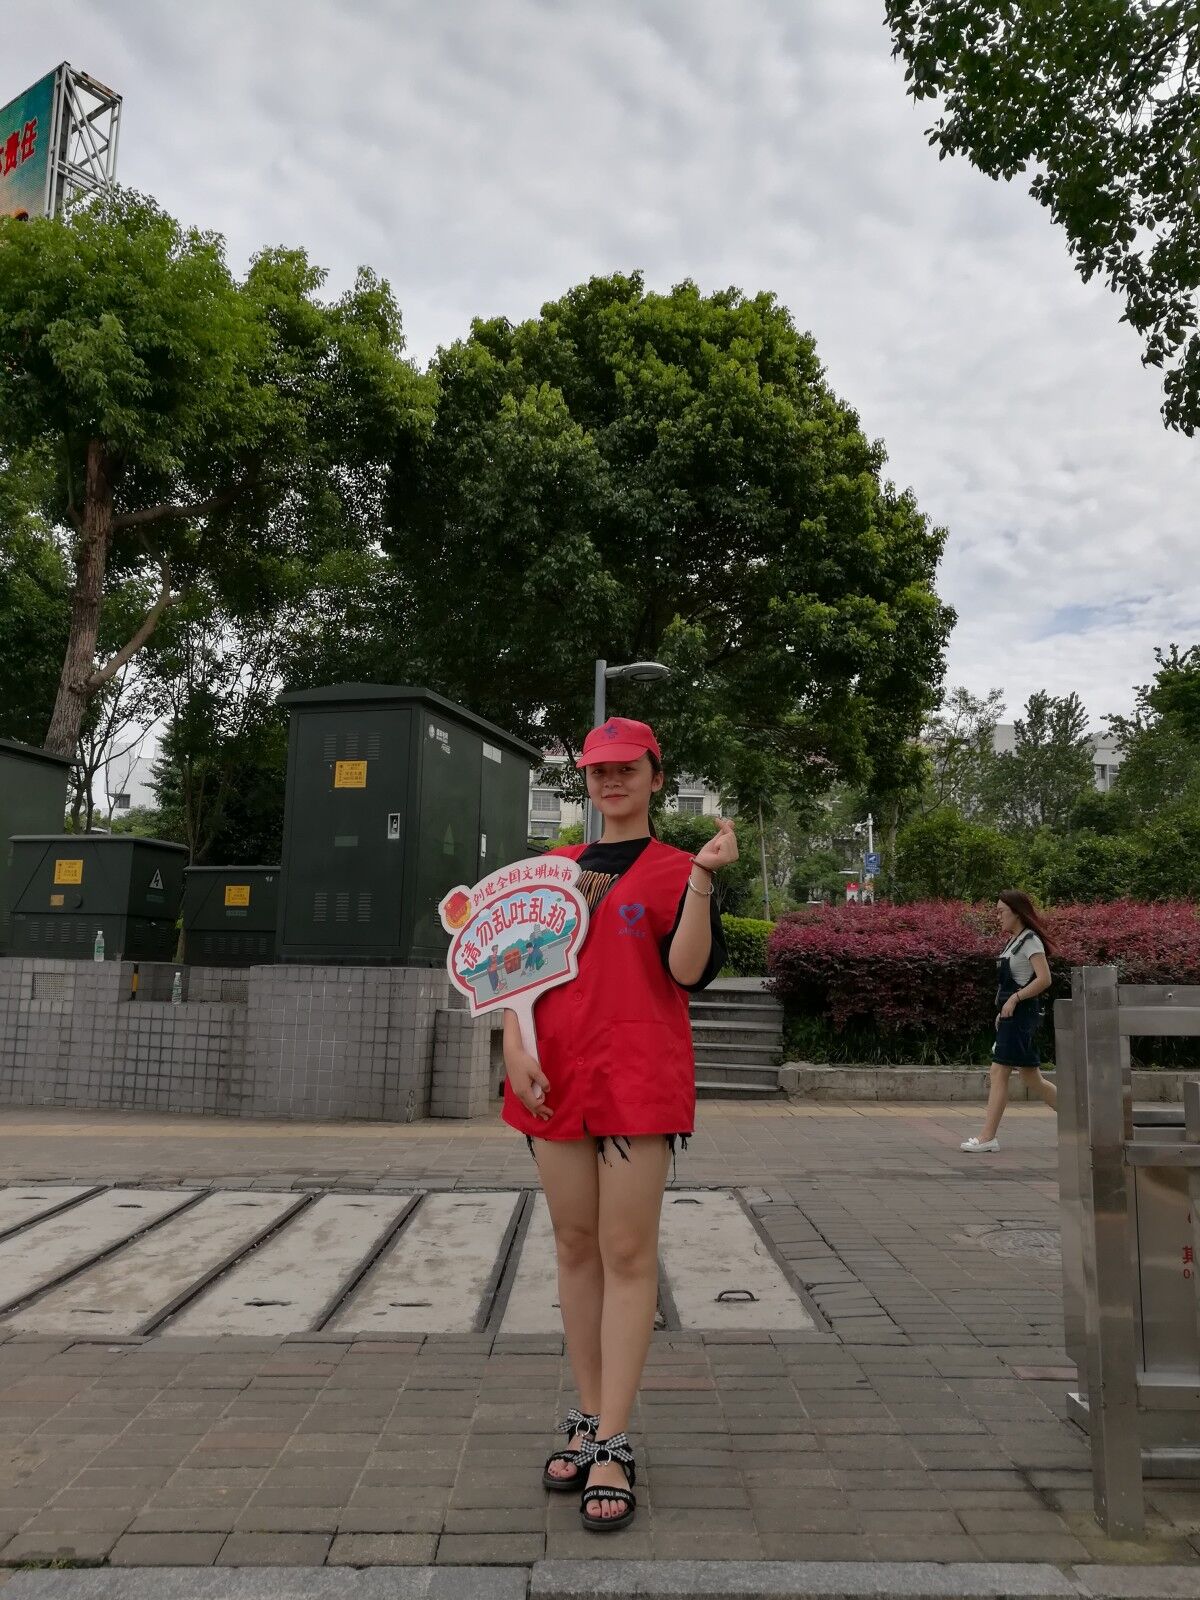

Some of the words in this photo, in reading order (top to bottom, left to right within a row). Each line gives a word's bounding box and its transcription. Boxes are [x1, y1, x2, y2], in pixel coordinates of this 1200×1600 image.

[0, 118, 38, 177] 责任
[473, 863, 573, 907] 创建全国文明城市
[461, 896, 567, 970] 请勿乱吐乱扔
